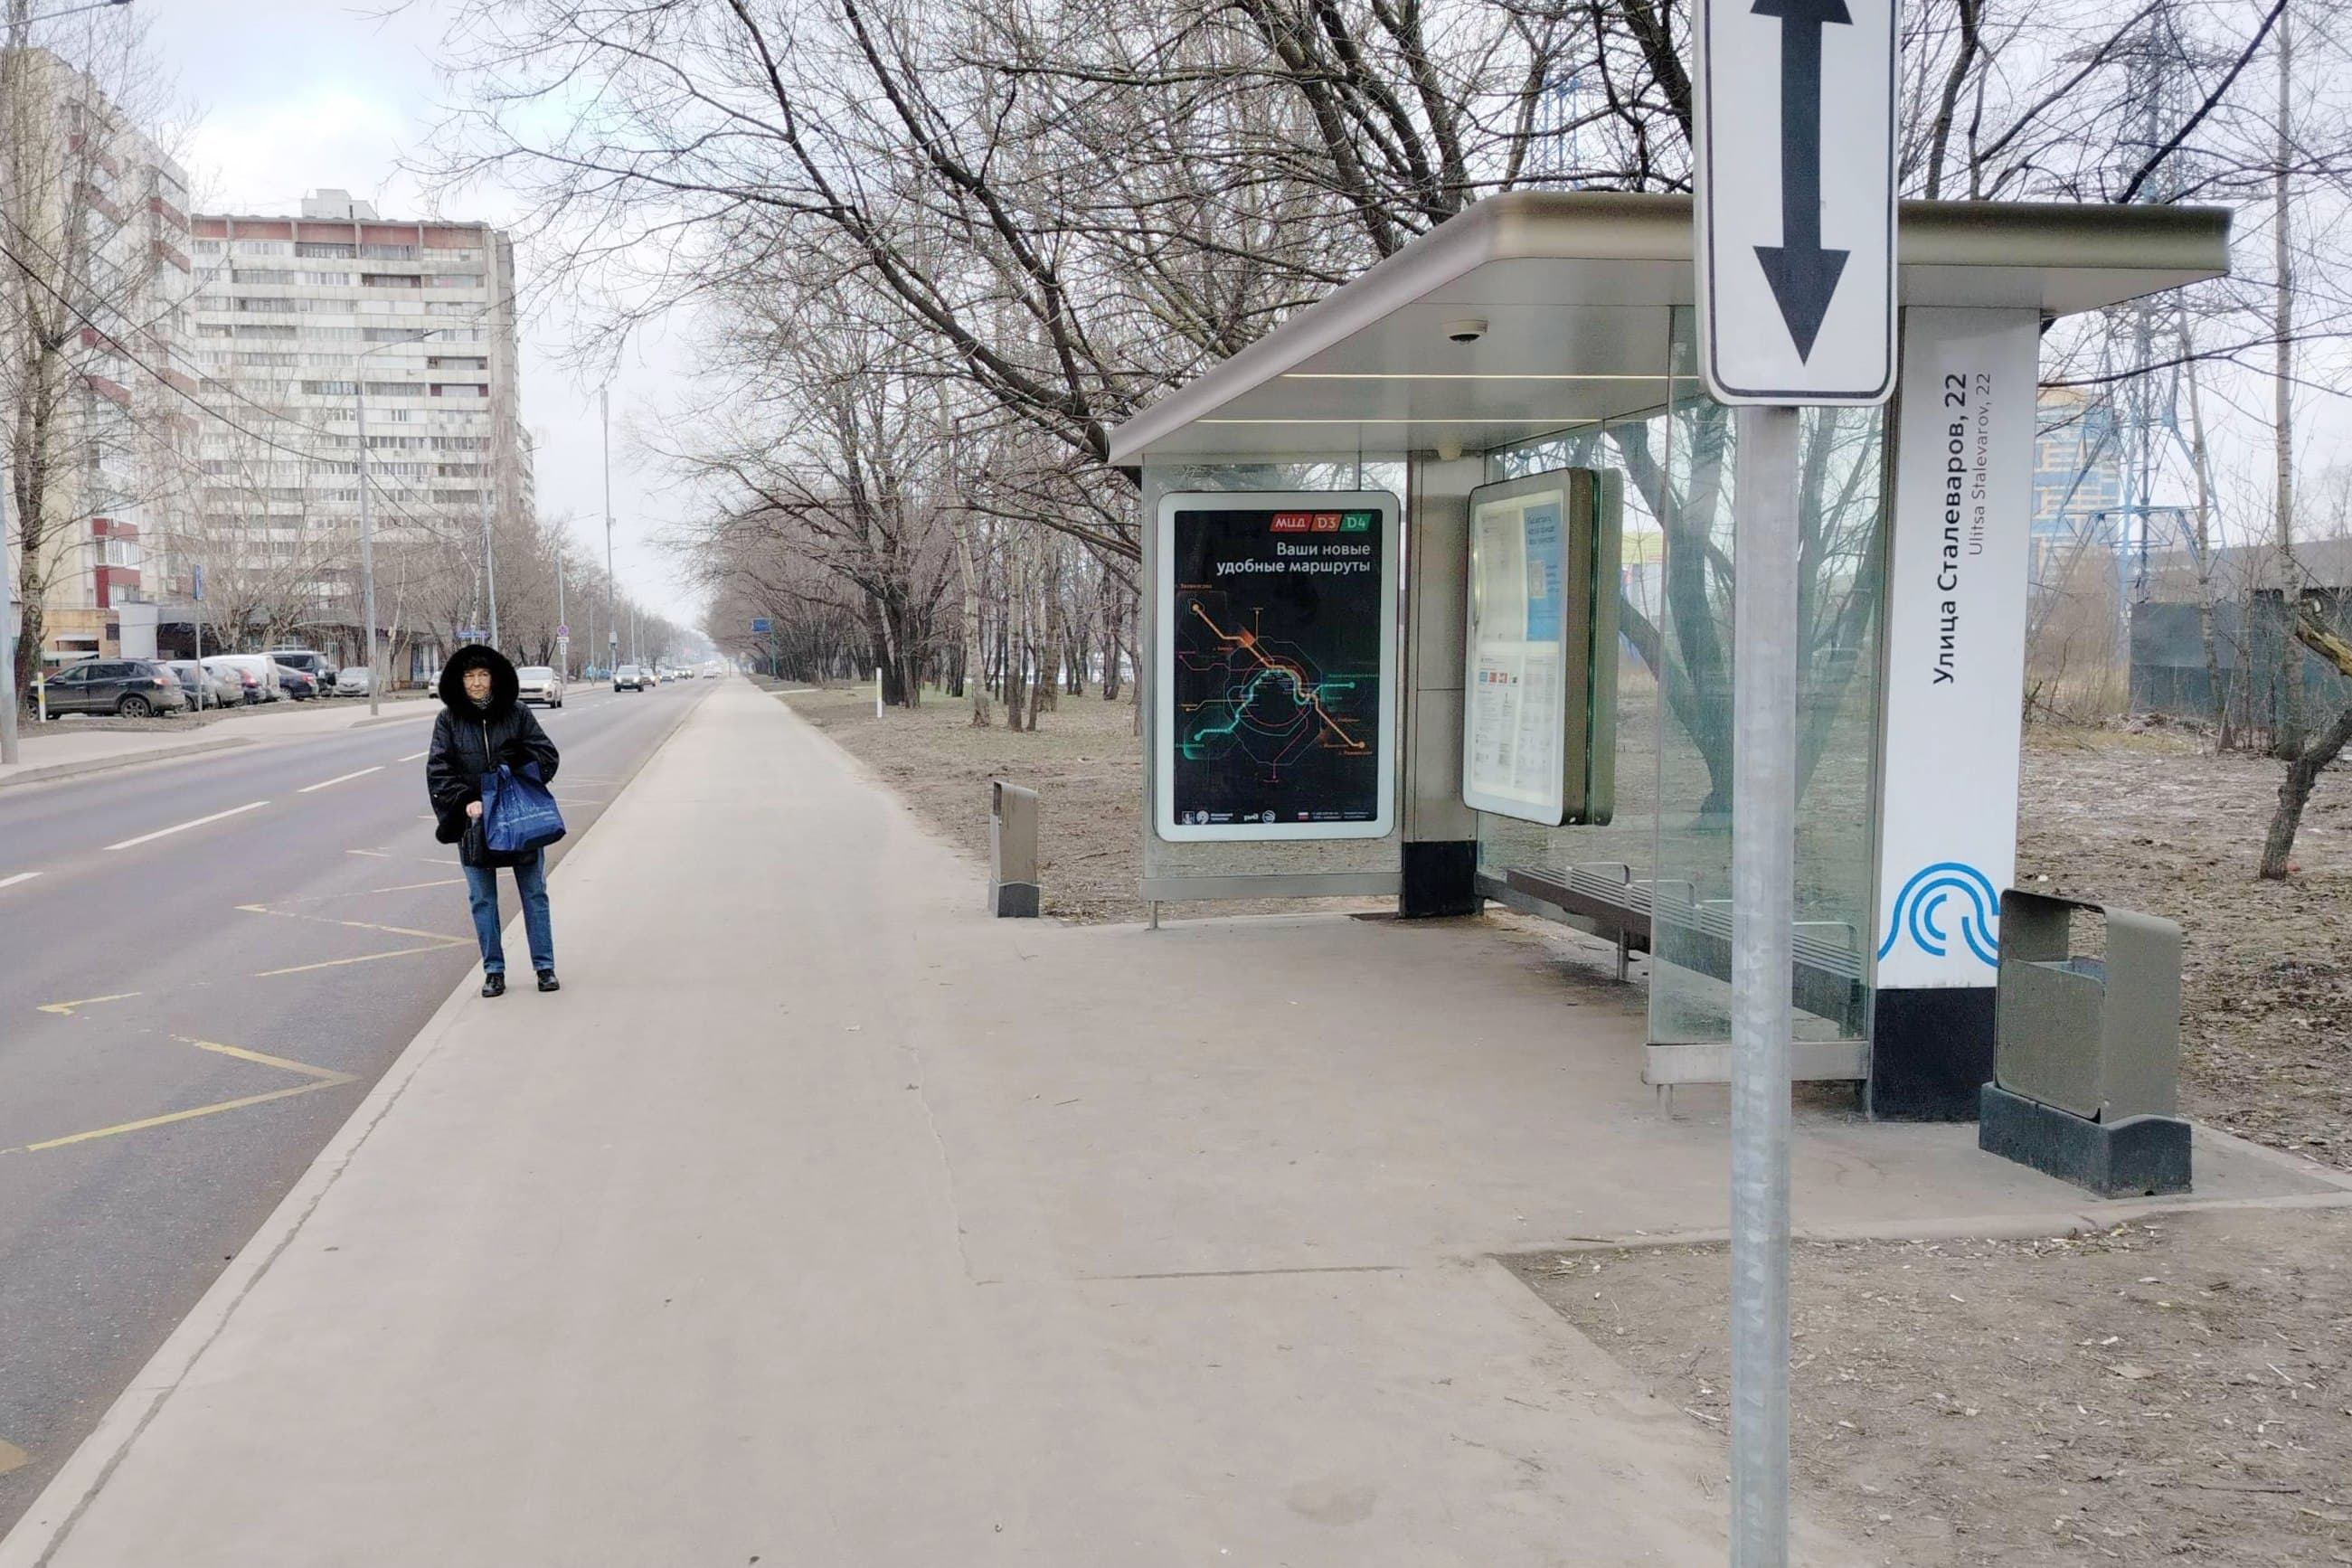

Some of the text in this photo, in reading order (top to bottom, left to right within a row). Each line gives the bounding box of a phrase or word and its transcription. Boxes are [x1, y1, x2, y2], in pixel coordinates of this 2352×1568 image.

[1969, 373, 1991, 556] Ulitsa Stalevarov, 22
[1275, 516, 1366, 529] МЦД D3 D4
[1932, 373, 1969, 685] Улица Сталеваров, 22
[1276, 542, 1371, 556] Ваши новые
[1216, 558, 1371, 576] удобные маршруты
